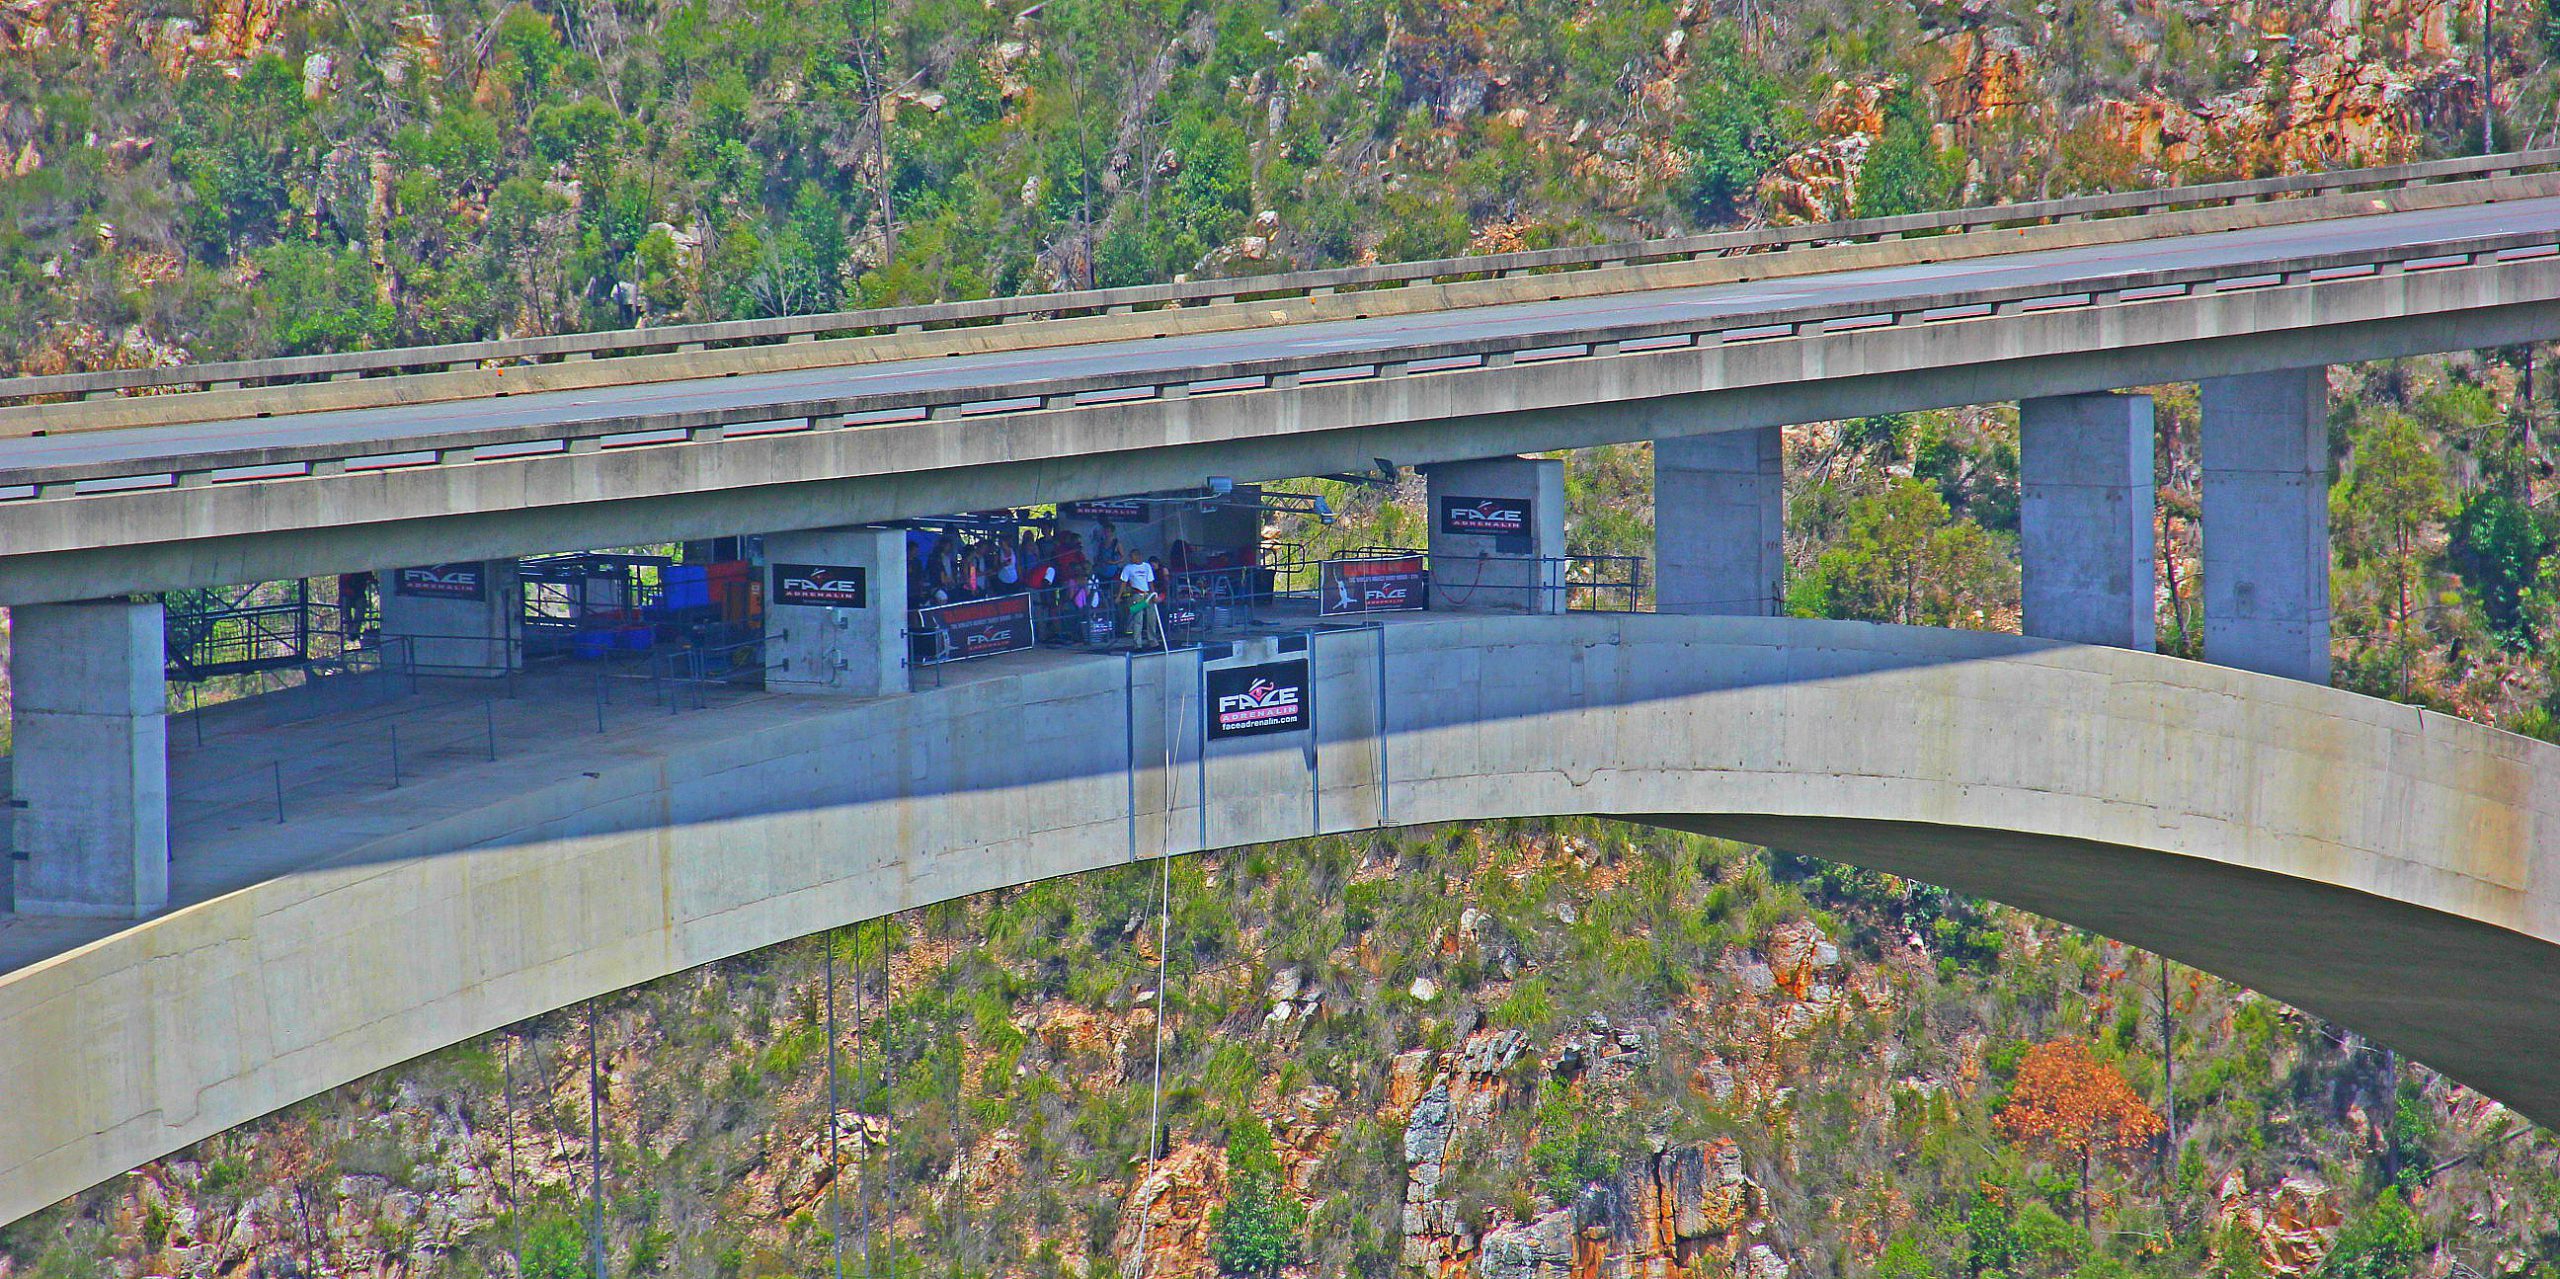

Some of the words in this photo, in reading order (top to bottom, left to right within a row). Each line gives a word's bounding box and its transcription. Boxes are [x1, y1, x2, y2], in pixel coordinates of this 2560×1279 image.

[1452, 520, 1520, 529] ADRENALIN
[785, 591, 853, 599] ADRENALIN
[1222, 706, 1297, 722] ADRENALIN
[1222, 715, 1298, 731] faceadrenalin.com
